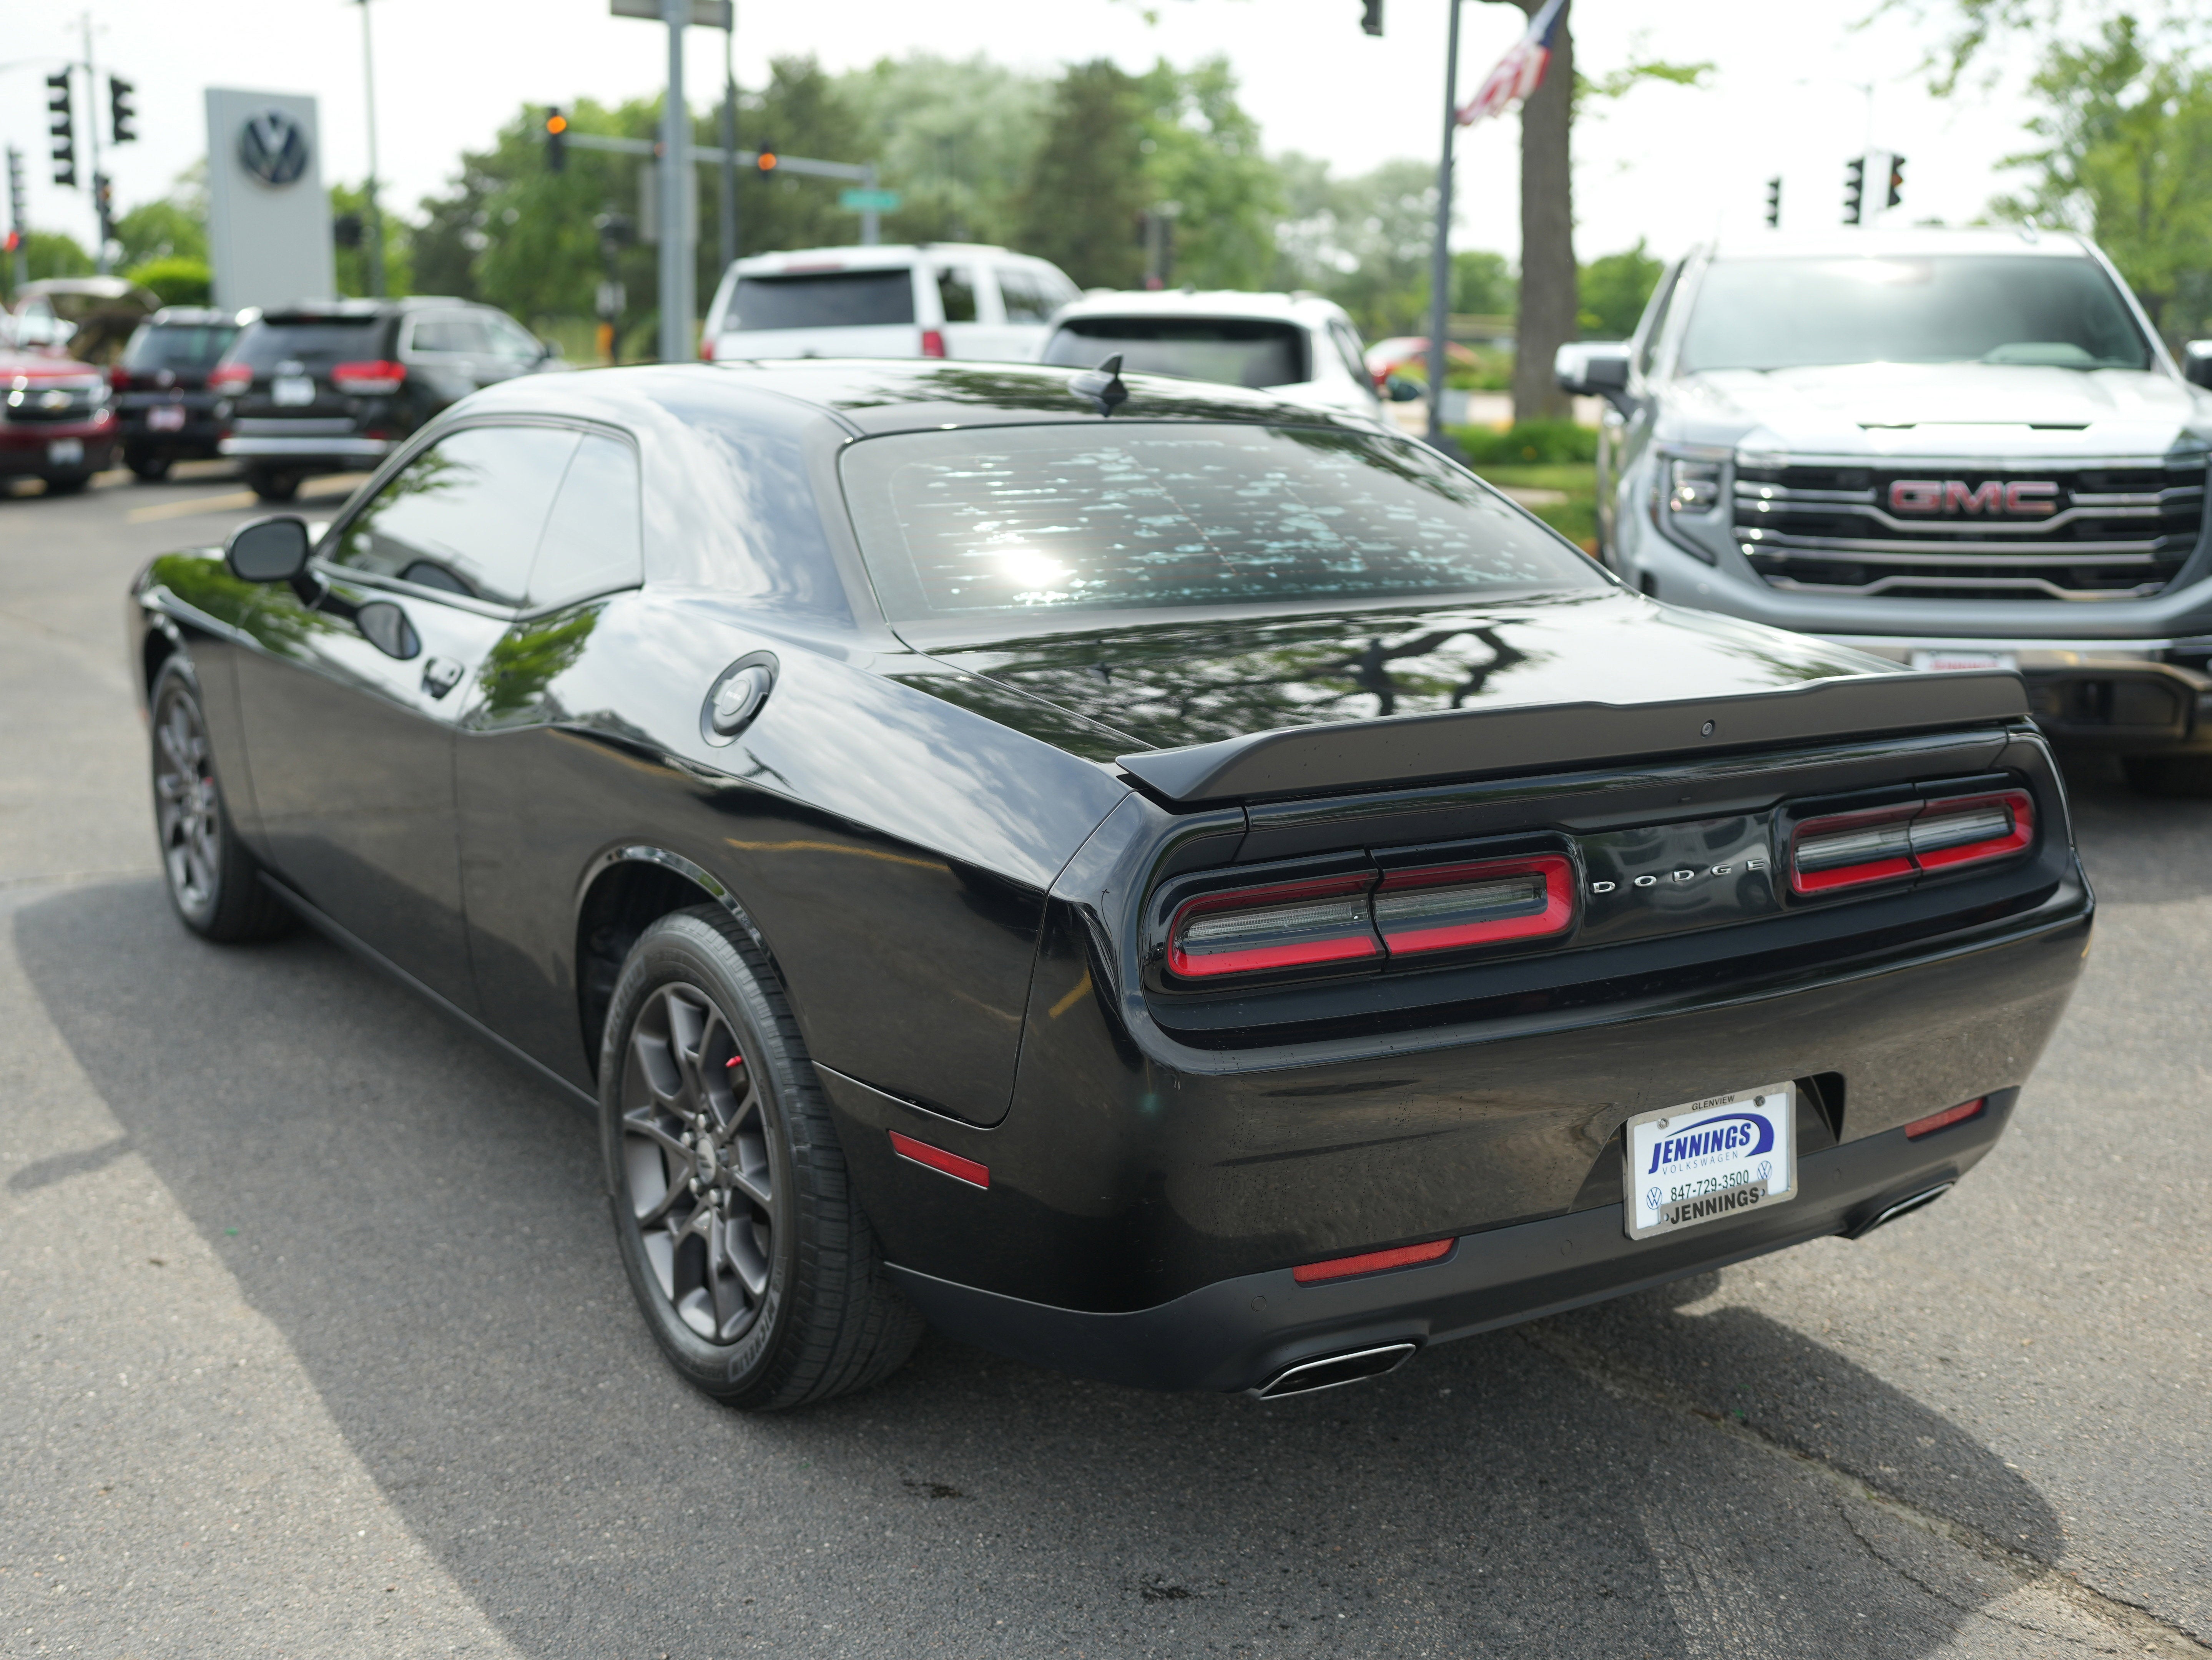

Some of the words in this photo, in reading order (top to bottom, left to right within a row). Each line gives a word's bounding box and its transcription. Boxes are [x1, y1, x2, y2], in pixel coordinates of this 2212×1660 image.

[1888, 480, 2059, 514] GMC
[1593, 858, 1765, 894] DODGE
[1692, 1095, 1735, 1110] GLENVIEW
[1649, 1122, 1751, 1174] JENNINGS
[1662, 1150, 1738, 1175] VOLKSWAGEN
[1671, 1170, 1749, 1202] 847-729-3500
[1671, 1187, 1760, 1224] JENNINGS
